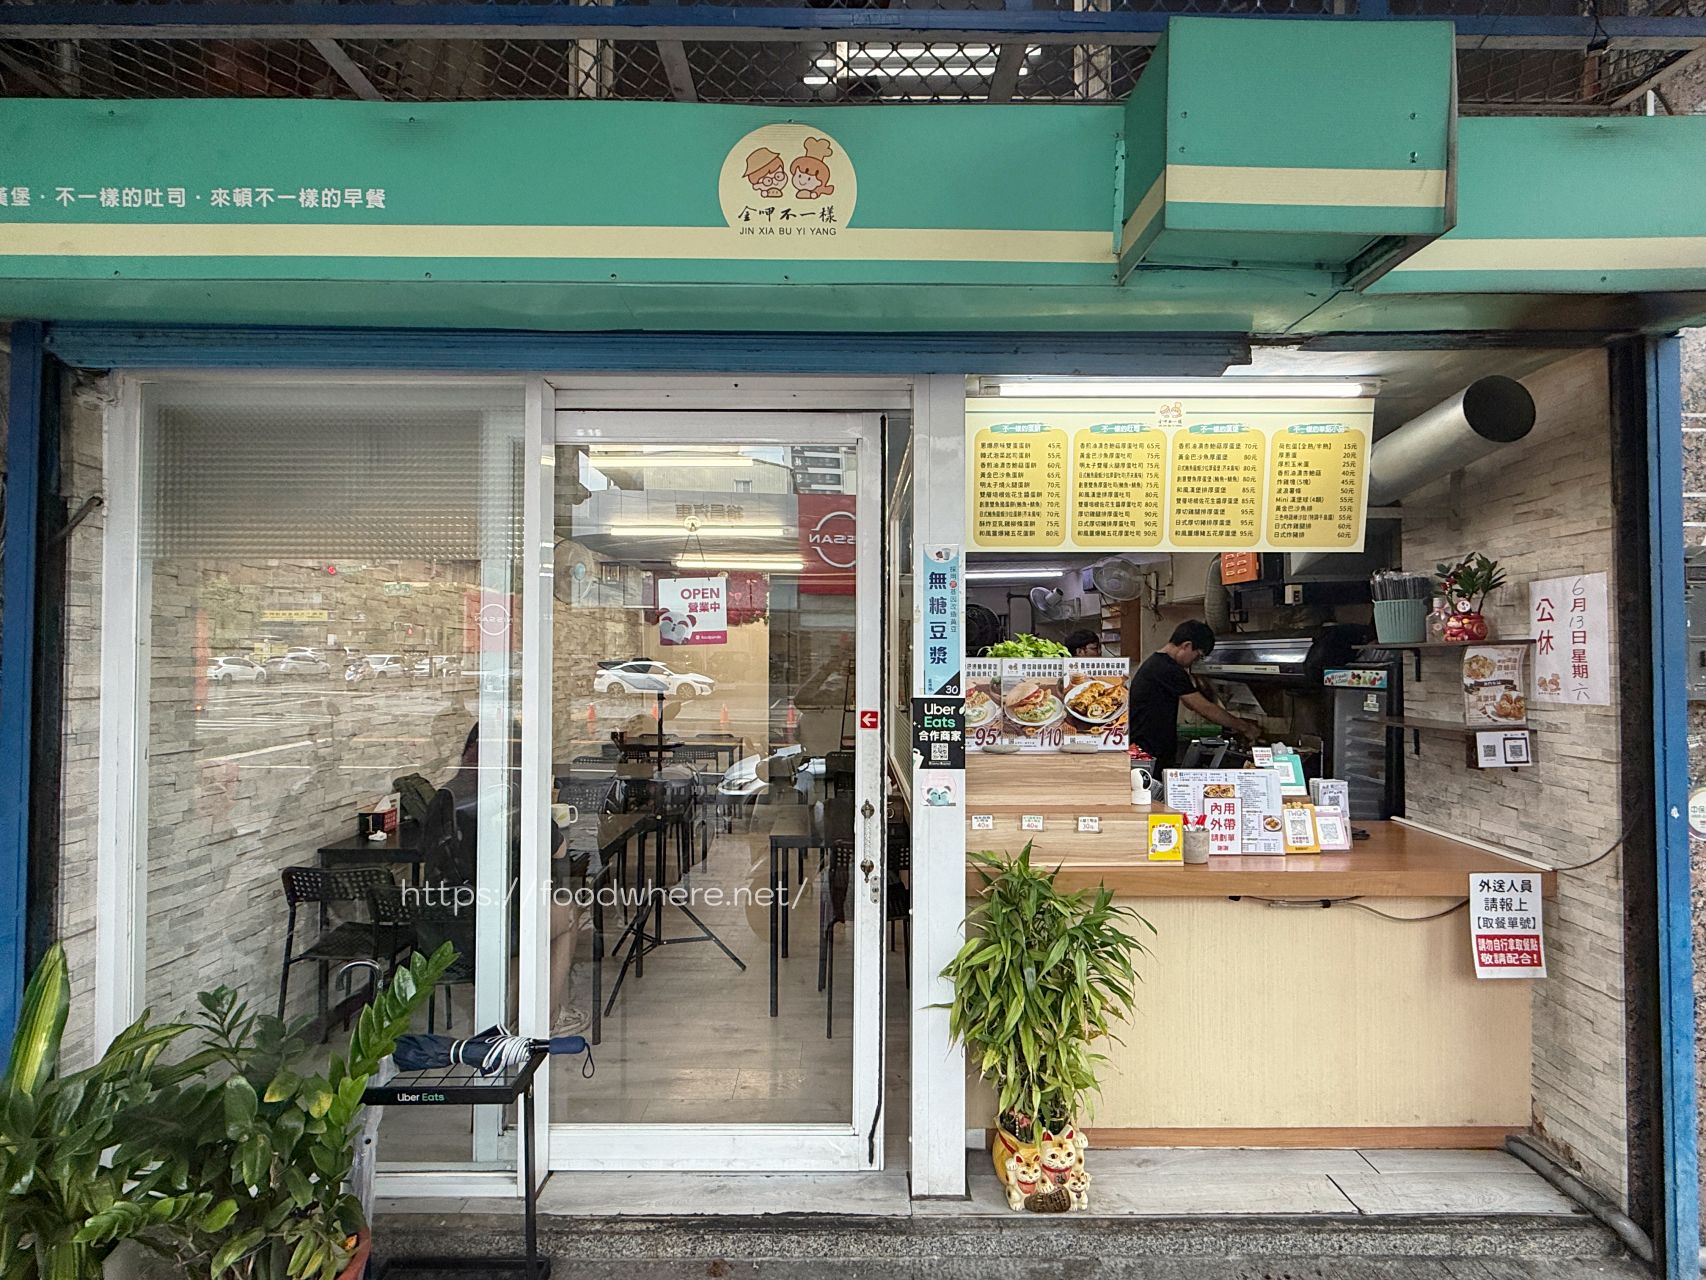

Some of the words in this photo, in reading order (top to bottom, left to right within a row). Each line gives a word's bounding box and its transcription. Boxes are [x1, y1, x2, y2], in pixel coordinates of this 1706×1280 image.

[740, 227, 755, 236] JIN
[758, 227, 774, 236] XIA
[779, 227, 792, 236] BU
[796, 227, 806, 236] YI
[809, 227, 837, 236] YANG
[1048, 443, 1062, 451] 45元
[1344, 443, 1358, 451] 15元
[1146, 462, 1160, 470] 75元
[1343, 461, 1357, 469] 25元
[1341, 479, 1356, 487] 45元
[1047, 491, 1061, 499] 70元
[1340, 496, 1354, 504] 55元
[1047, 501, 1061, 509] 70元
[1145, 501, 1159, 509] 80元
[1339, 505, 1354, 513] 55元
[1046, 510, 1060, 518] 70元
[1241, 508, 1256, 516] 95元
[1338, 514, 1353, 522] 55元
[1046, 520, 1060, 528] 75元
[1144, 520, 1158, 528] 90元
[1241, 519, 1255, 527] 95元
[1338, 523, 1353, 531] 60元
[1046, 530, 1060, 538] 80元
[1144, 530, 1158, 538] 90元
[1240, 530, 1255, 538] 95元
[1337, 532, 1352, 540] 60元
[680, 588, 720, 599] OPEN
[688, 601, 721, 613] 營業中
[929, 571, 948, 665] 無糖豆漿
[1536, 598, 1554, 655] 公休
[945, 685, 959, 695] 30
[924, 703, 956, 715] Uber
[924, 716, 956, 728] Eats
[918, 730, 962, 741] 合作商家
[975, 728, 997, 746] 95
[1039, 728, 1061, 746] 110
[1103, 727, 1123, 745] 75
[1211, 803, 1235, 815] 內用
[1211, 818, 1236, 831] 外帶
[1211, 833, 1235, 842] 請劃單
[1479, 879, 1533, 893] 外送人員
[1484, 897, 1528, 912] 請報上
[1477, 916, 1536, 929] 【取餐單號】
[397, 1093, 420, 1102] Uber
[421, 1093, 445, 1102] Eats
